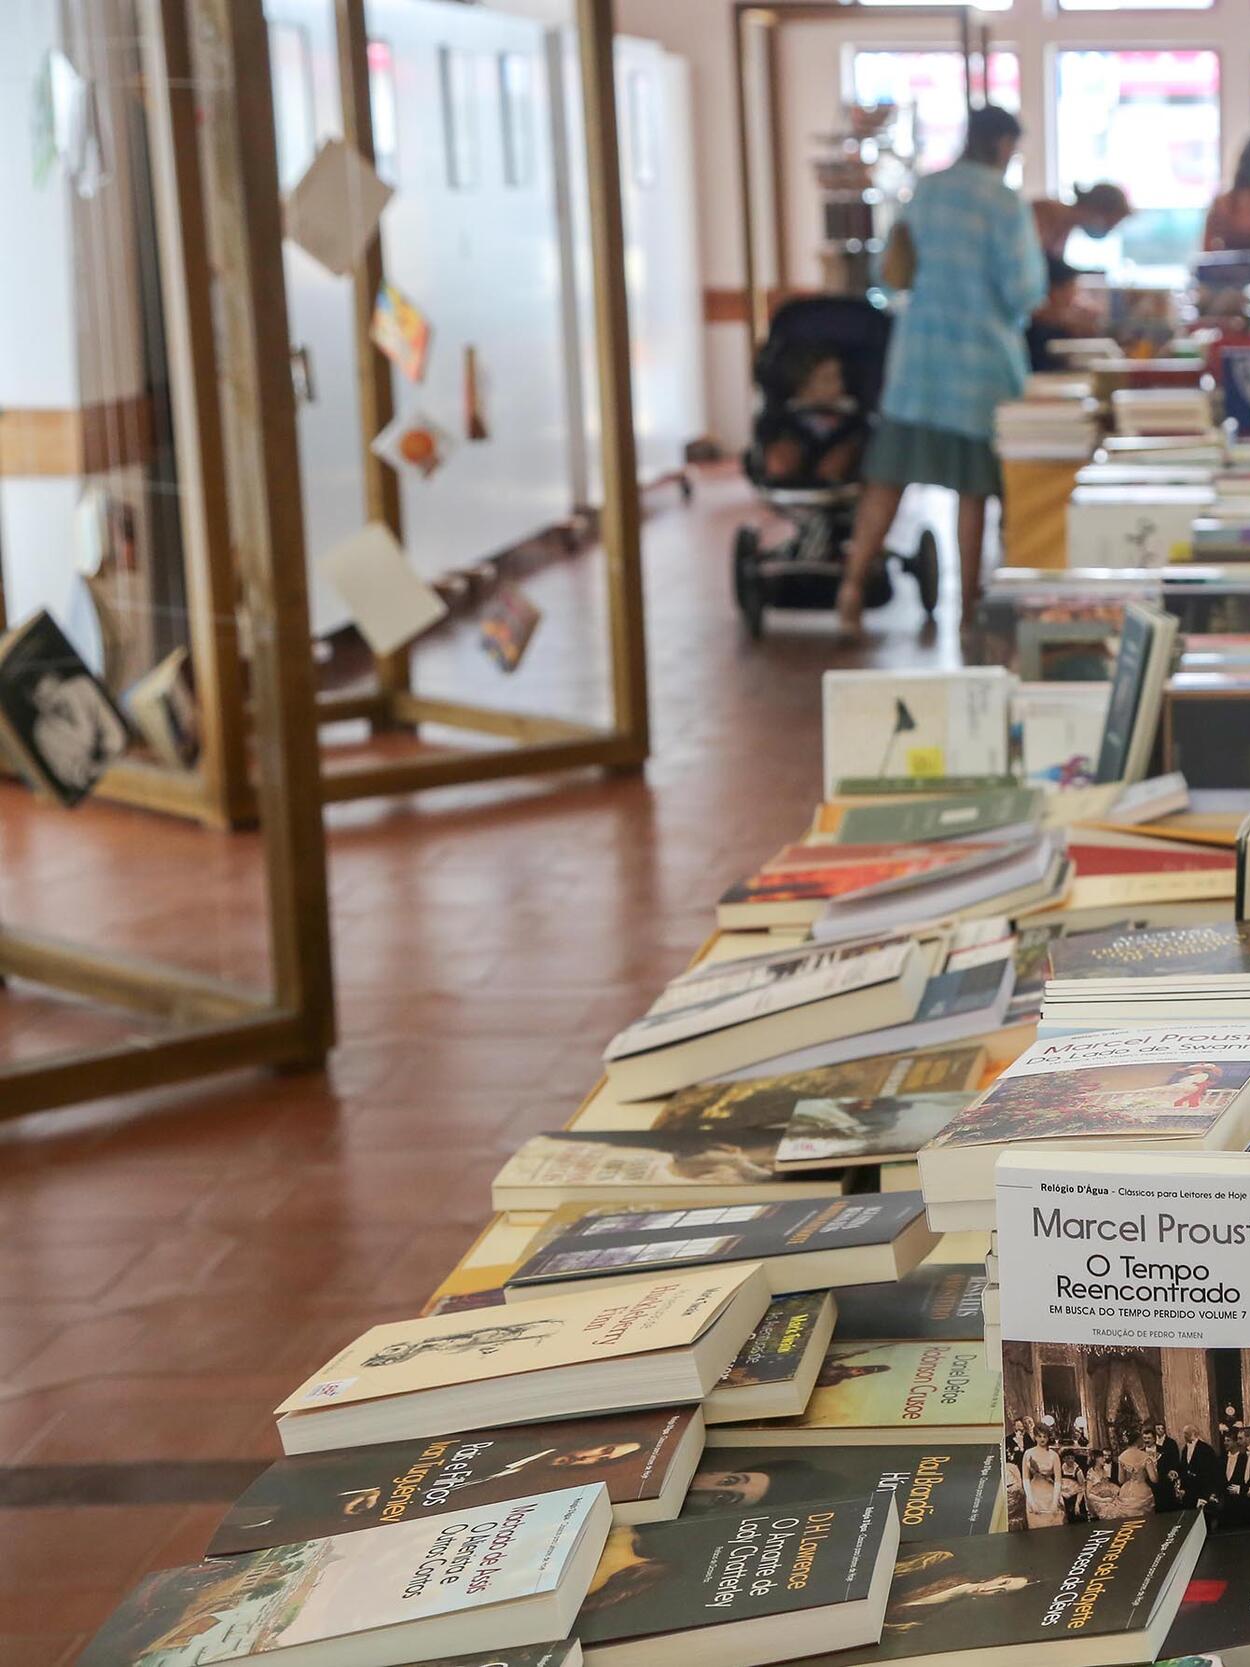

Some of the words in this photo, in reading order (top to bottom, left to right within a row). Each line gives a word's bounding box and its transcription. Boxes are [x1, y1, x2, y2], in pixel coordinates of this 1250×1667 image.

[1026, 1055, 1061, 1065] Do
[1069, 1049, 1132, 1060] Lado
[1140, 1045, 1170, 1054] de
[1042, 1035, 1151, 1056] Marcel
[1041, 1183, 1074, 1194] Relógio
[1077, 1185, 1109, 1196] D'Água
[1118, 1187, 1155, 1198] Clássicos
[1157, 1191, 1178, 1199] para
[1180, 1191, 1212, 1200] Leitores
[1215, 1191, 1226, 1200] de
[1228, 1191, 1247, 1201] Hoje
[1032, 1206, 1146, 1242] Marcel
[1086, 1253, 1111, 1277] O
[1120, 1255, 1210, 1286] Tempo
[1057, 1274, 1241, 1304] Reencontrado
[583, 1305, 629, 1332] Finn
[592, 1283, 680, 1346] Huckleberry
[1050, 1304, 1063, 1314] EM
[1065, 1306, 1096, 1316] BUSCA
[1099, 1307, 1115, 1317] DO
[1118, 1308, 1150, 1318] TEMPO
[1153, 1309, 1195, 1319] PERDIDO
[1198, 1310, 1238, 1320] VOLUME
[1241, 1311, 1247, 1320] 7
[1092, 1327, 1135, 1338] TRADUÇÃO
[1137, 1329, 1148, 1338] DE
[1149, 1330, 1176, 1339] PEDRO
[1178, 1331, 1203, 1340] TAMEN
[913, 1346, 951, 1384] Robinson
[949, 1354, 977, 1377] Daniel
[902, 1384, 938, 1420] Crusoe
[940, 1378, 970, 1404] Defoe
[424, 1439, 461, 1460] Ivan
[453, 1441, 495, 1463] Pais
[917, 1456, 951, 1477] Raul
[423, 1468, 473, 1506] Filhos
[902, 1475, 944, 1526] Brandão
[470, 1522, 498, 1533] O
[489, 1503, 538, 1551] Machado
[728, 1516, 770, 1544] Lady
[771, 1518, 799, 1529] O
[1090, 1529, 1115, 1537] A
[425, 1523, 469, 1563] Outros
[447, 1534, 484, 1576] Alienista
[755, 1533, 796, 1577] Amante
[1102, 1520, 1146, 1562] Madame
[480, 1550, 502, 1566] de
[787, 1535, 829, 1590] Lawrence
[1068, 1536, 1110, 1577] Princesa
[1094, 1562, 1119, 1577] de
[402, 1559, 447, 1599] Contos
[466, 1566, 502, 1595] Assis
[705, 1545, 759, 1608] Chatterley
[749, 1579, 778, 1596] de
[1060, 1577, 1085, 1591] de
[1067, 1575, 1115, 1630] Lafayette
